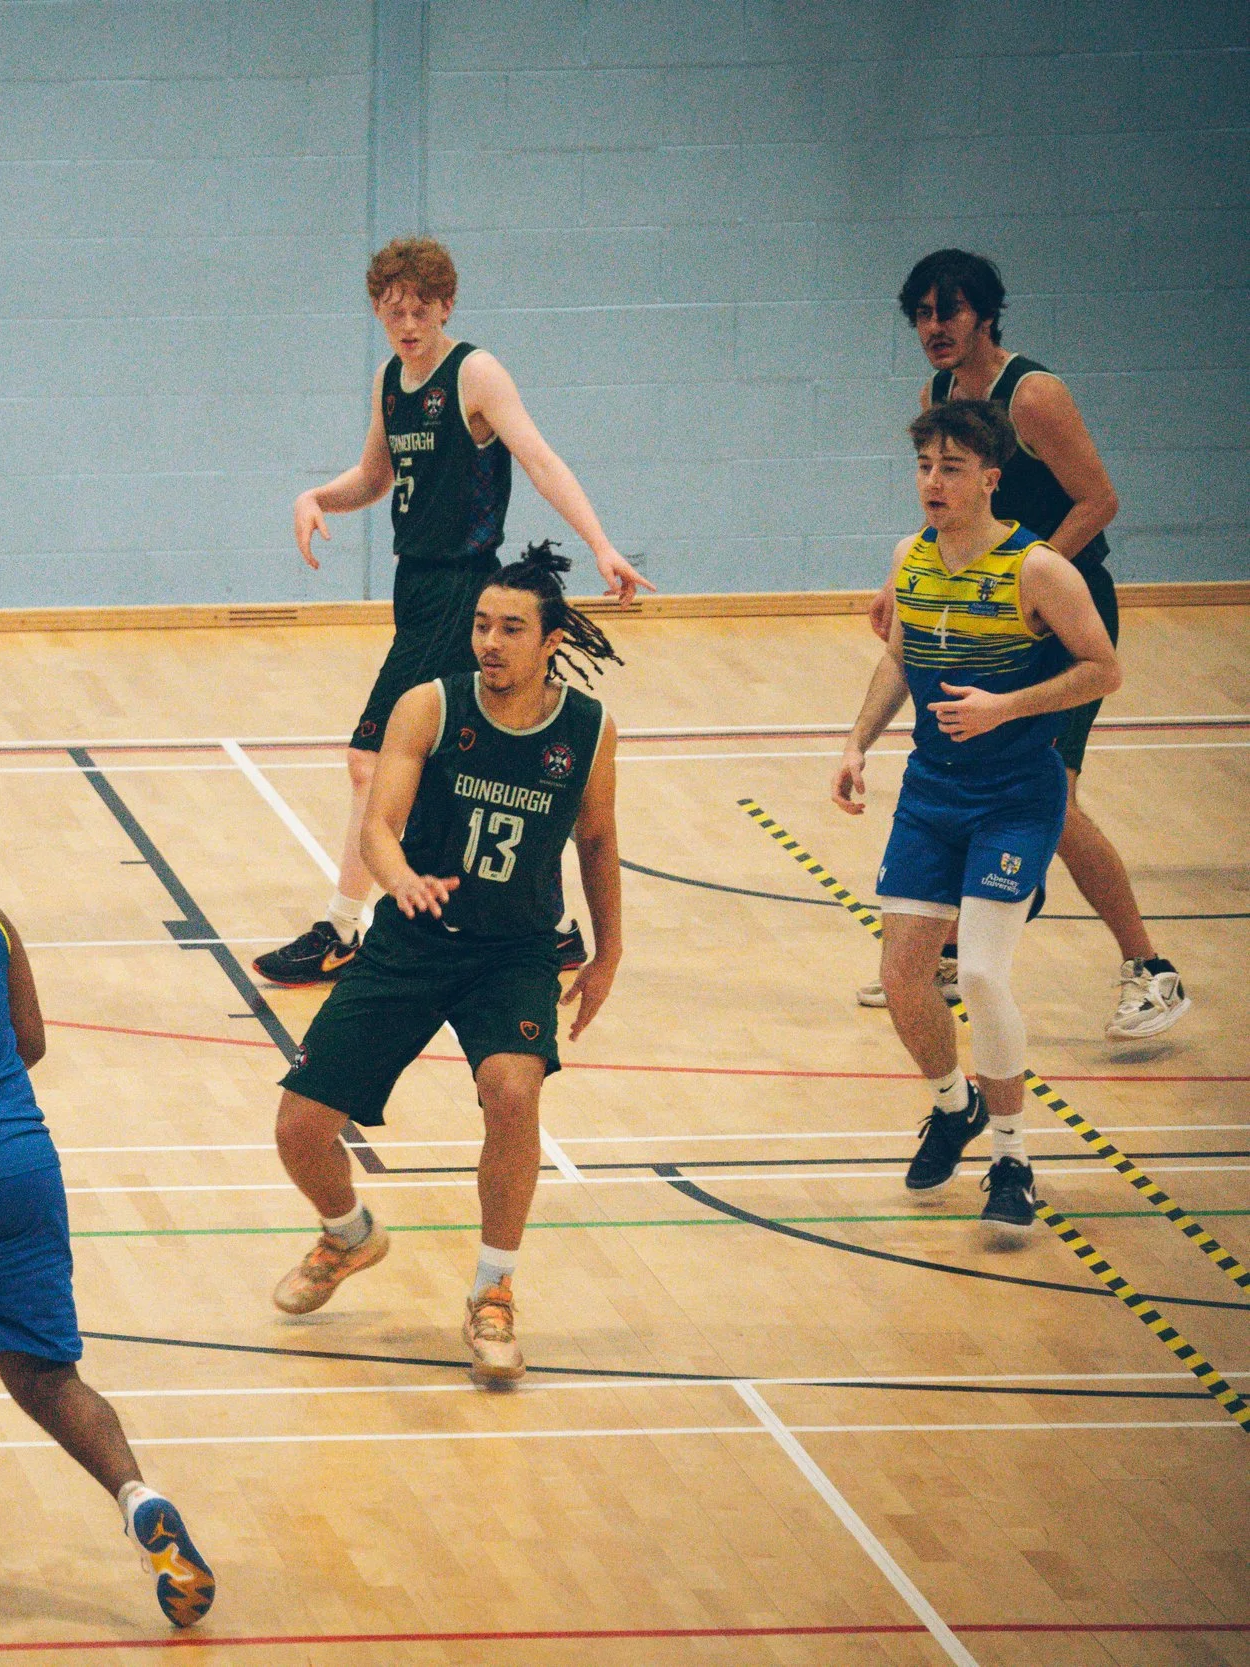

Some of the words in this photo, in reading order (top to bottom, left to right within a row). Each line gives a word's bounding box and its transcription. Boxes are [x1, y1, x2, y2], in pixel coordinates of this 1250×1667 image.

[394, 457, 415, 513] 5
[933, 604, 950, 649] 4
[454, 773, 553, 814] EDINBURGH
[463, 807, 524, 883] 13
[981, 877, 1021, 895] University
